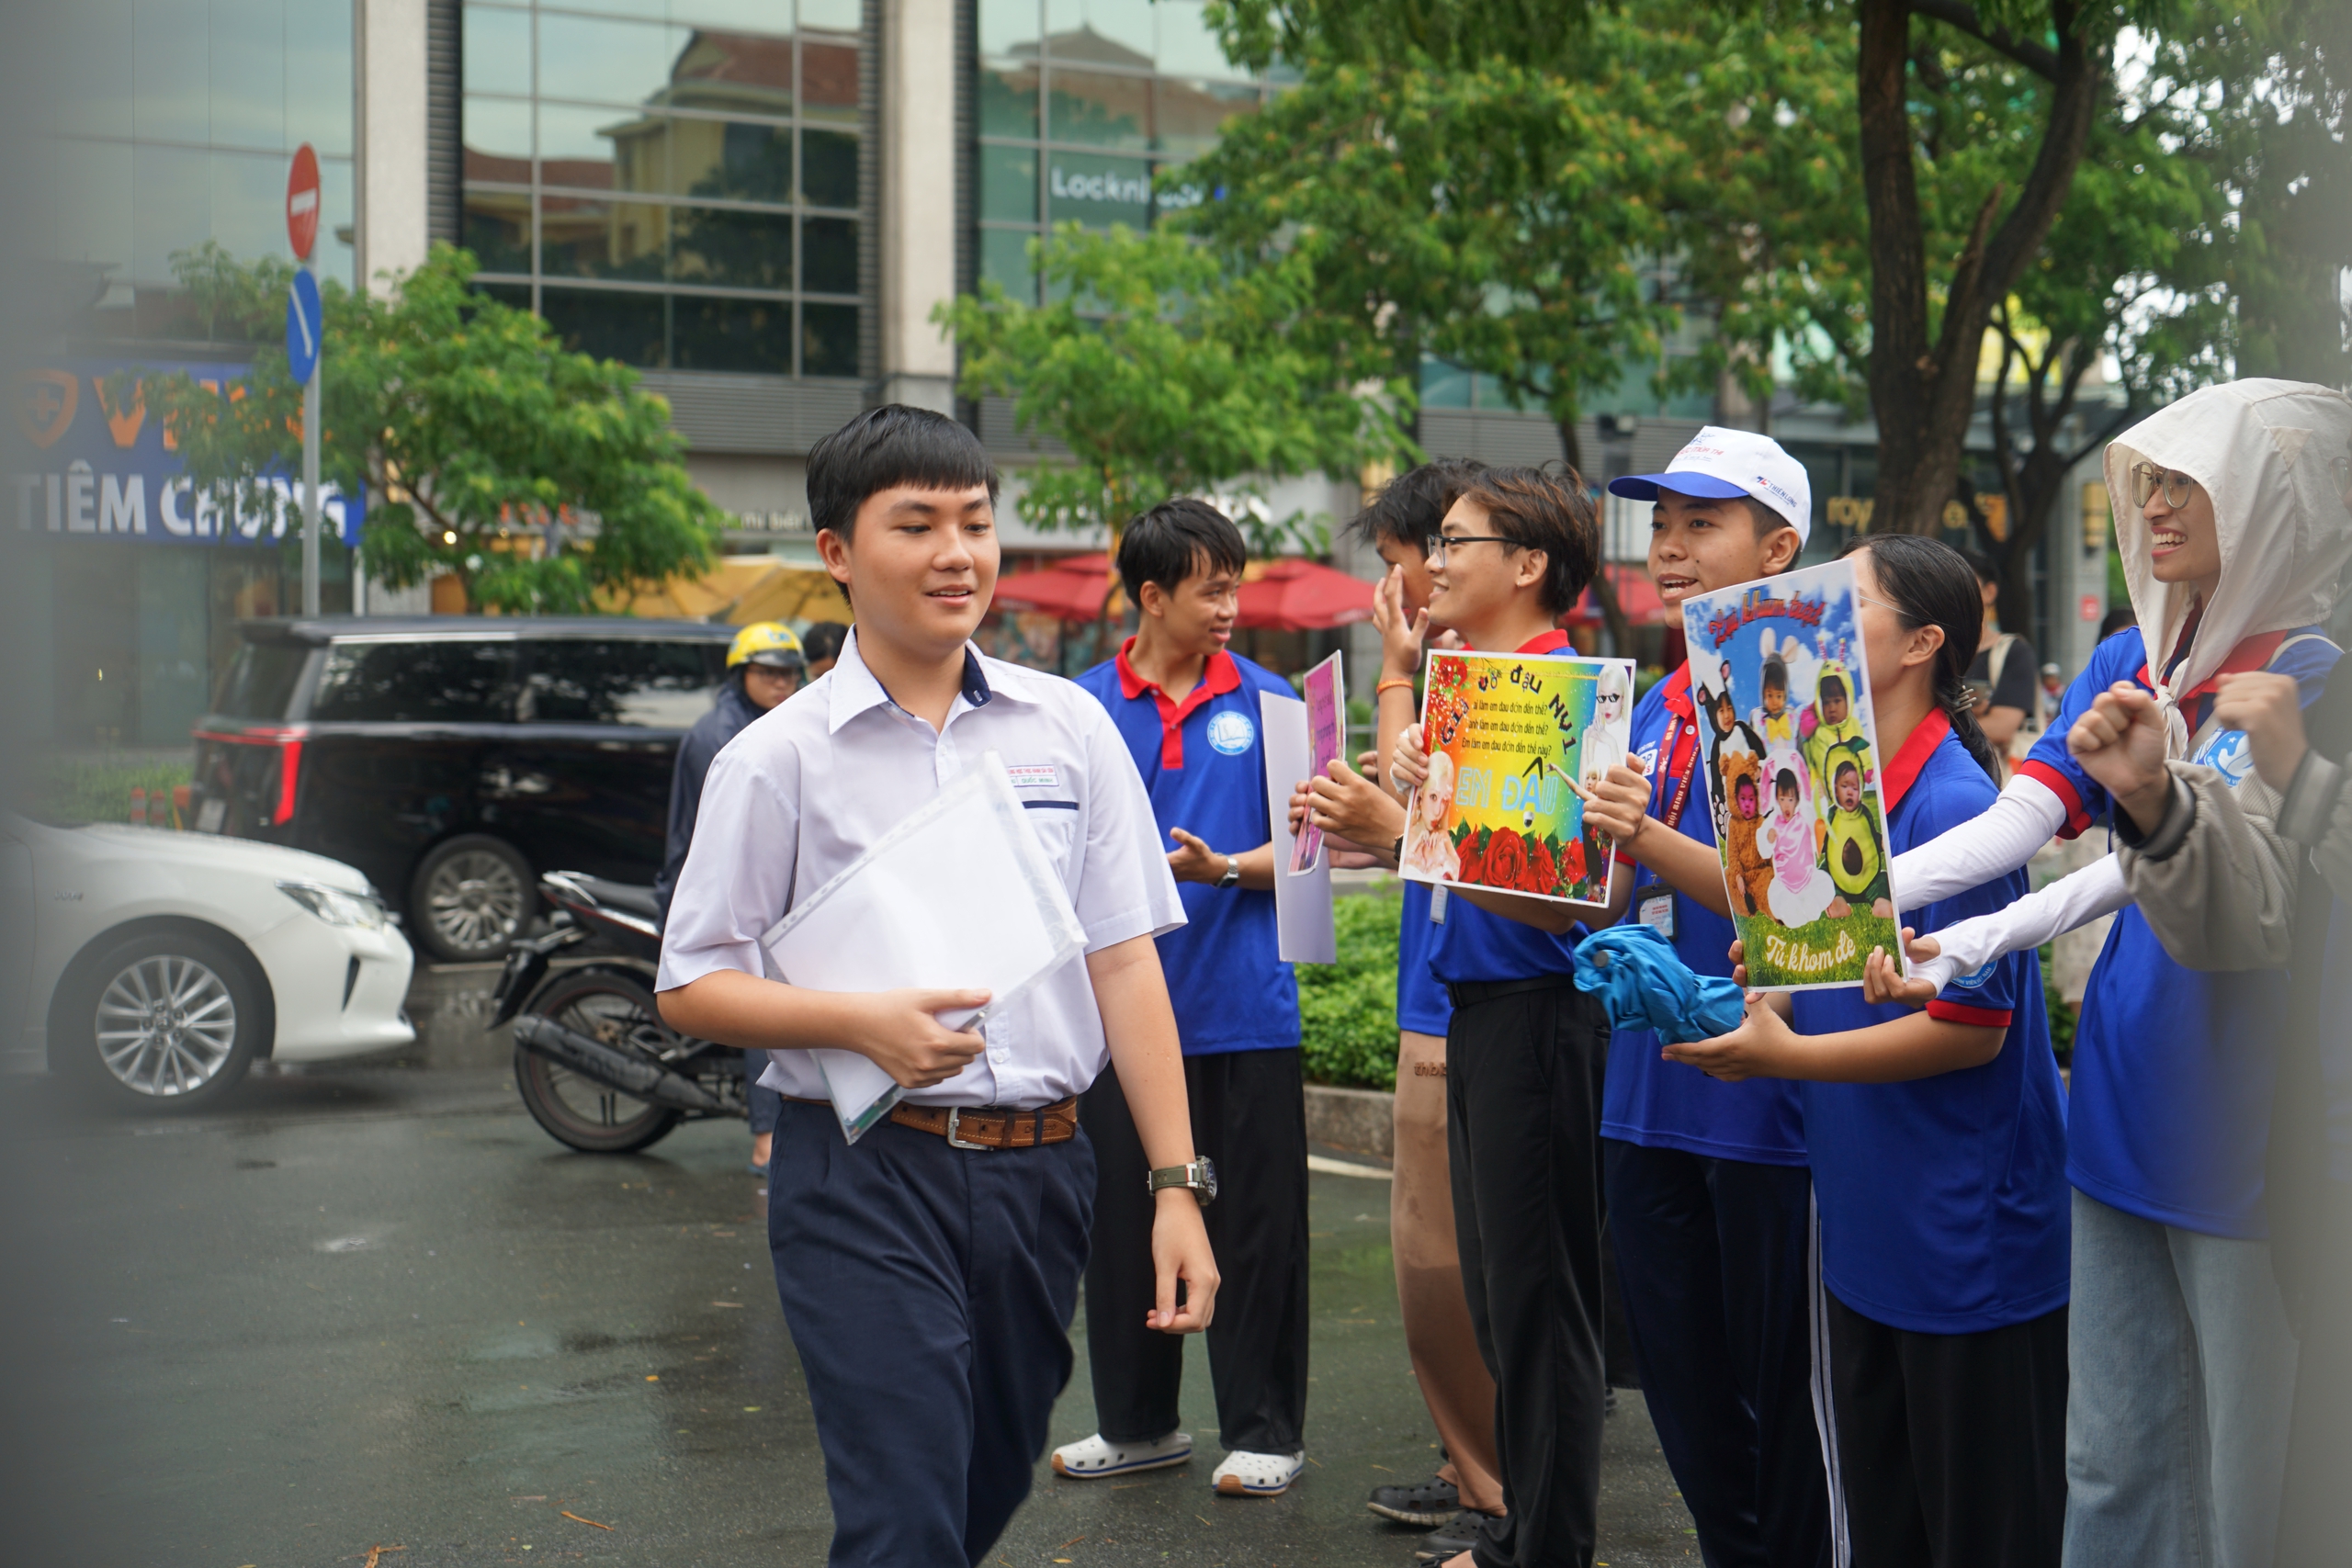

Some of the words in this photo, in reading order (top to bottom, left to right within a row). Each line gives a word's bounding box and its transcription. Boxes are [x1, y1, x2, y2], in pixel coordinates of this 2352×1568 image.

[1479, 700, 1488, 710] làm
[1490, 703, 1498, 711] em
[1499, 702, 1509, 712] đau
[1480, 719, 1488, 729] làm
[1490, 722, 1498, 731] em
[1499, 721, 1509, 732] đau
[1462, 738, 1470, 747] Em
[1471, 738, 1480, 749] làm
[1491, 740, 1500, 751] đau
[1455, 766, 1492, 808] EM
[1788, 942, 1834, 972] khom
